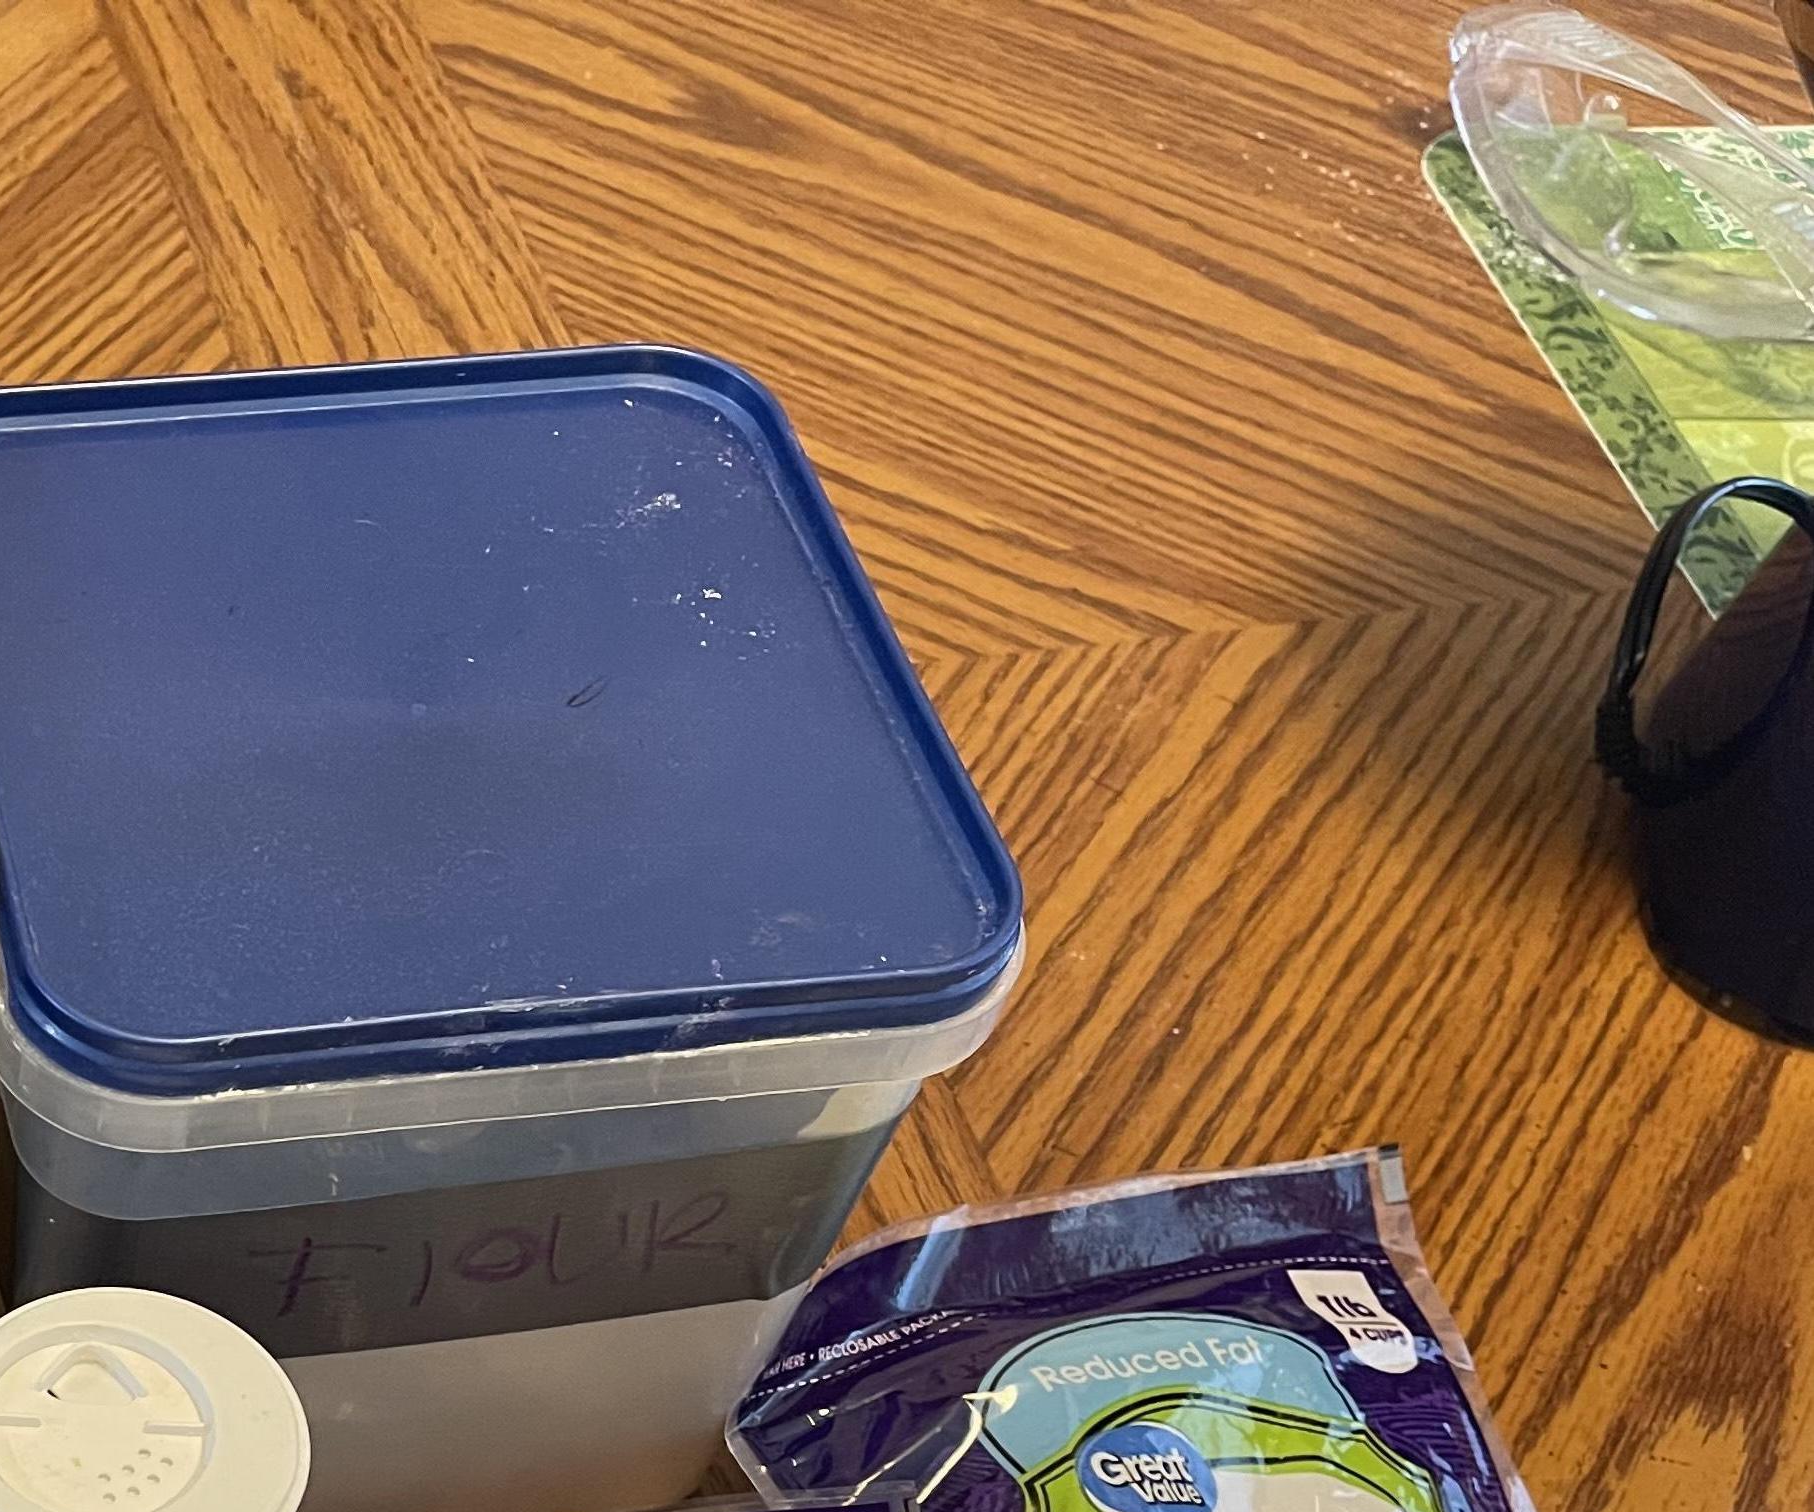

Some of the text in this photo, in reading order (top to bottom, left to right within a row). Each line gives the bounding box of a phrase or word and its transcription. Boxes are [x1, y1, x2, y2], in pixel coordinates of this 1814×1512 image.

[1316, 1294, 1378, 1318] 1lb
[781, 1311, 950, 1371] HERE RECLOSABLE PACKA
[1030, 1335, 1264, 1393] Reduced Fat
[1090, 1446, 1194, 1486] Great
[1130, 1473, 1204, 1507] Value
